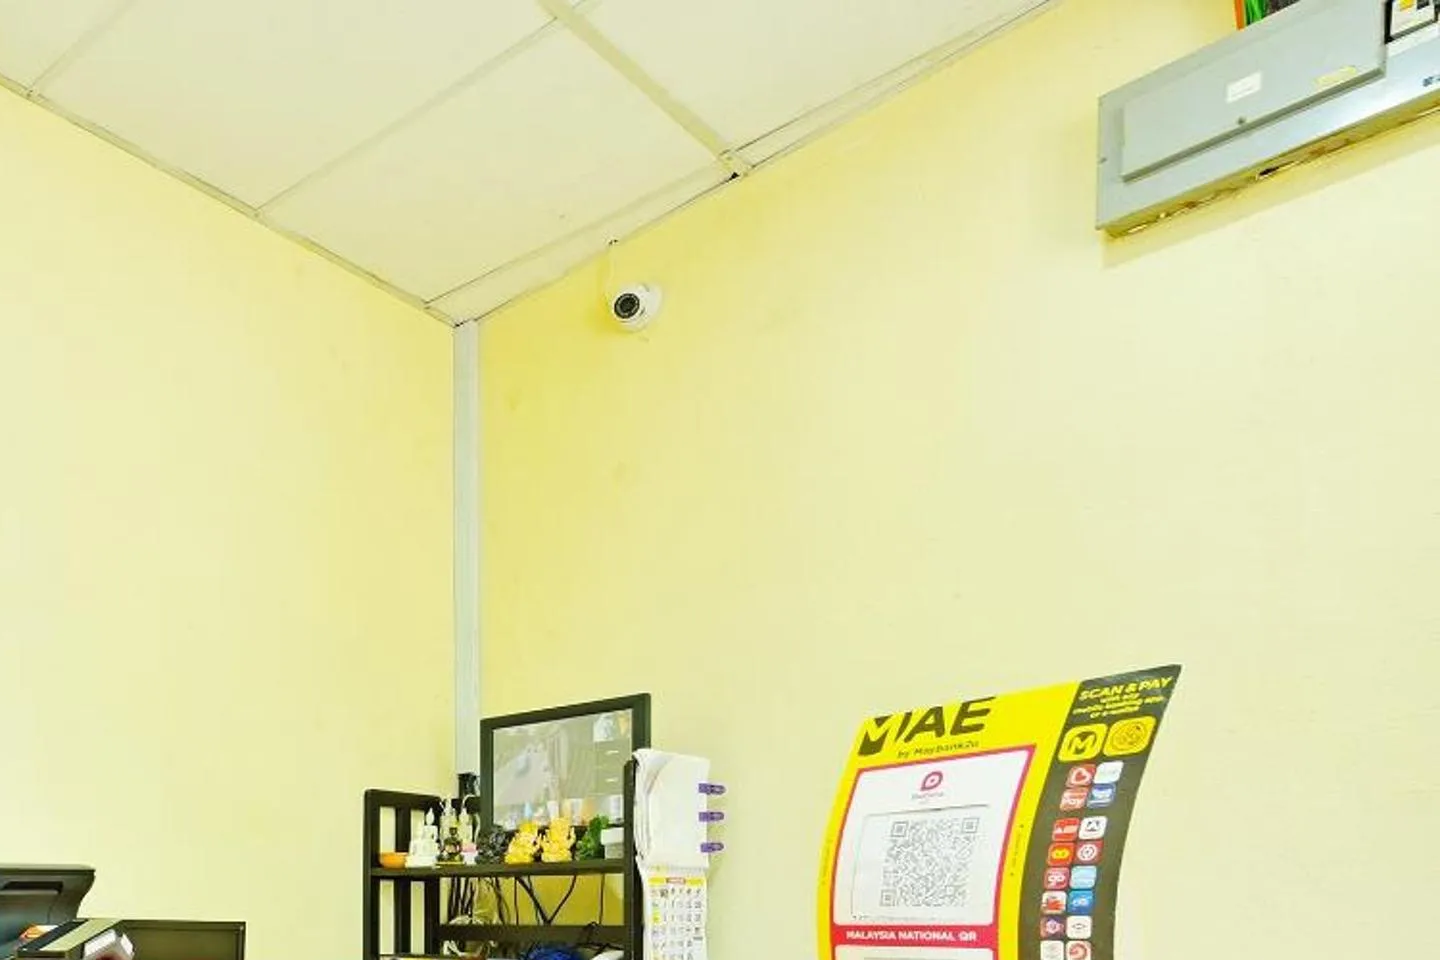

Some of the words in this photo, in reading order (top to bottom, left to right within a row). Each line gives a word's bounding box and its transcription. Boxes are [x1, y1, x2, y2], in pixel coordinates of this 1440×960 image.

[1078, 684, 1125, 701] SCAN
[1125, 682, 1138, 694] &
[1138, 675, 1174, 691] PAY
[857, 695, 997, 757] MAE
[845, 930, 897, 941] MALAYSIA
[897, 930, 957, 942] NATIONAL
[958, 931, 977, 943] QR
